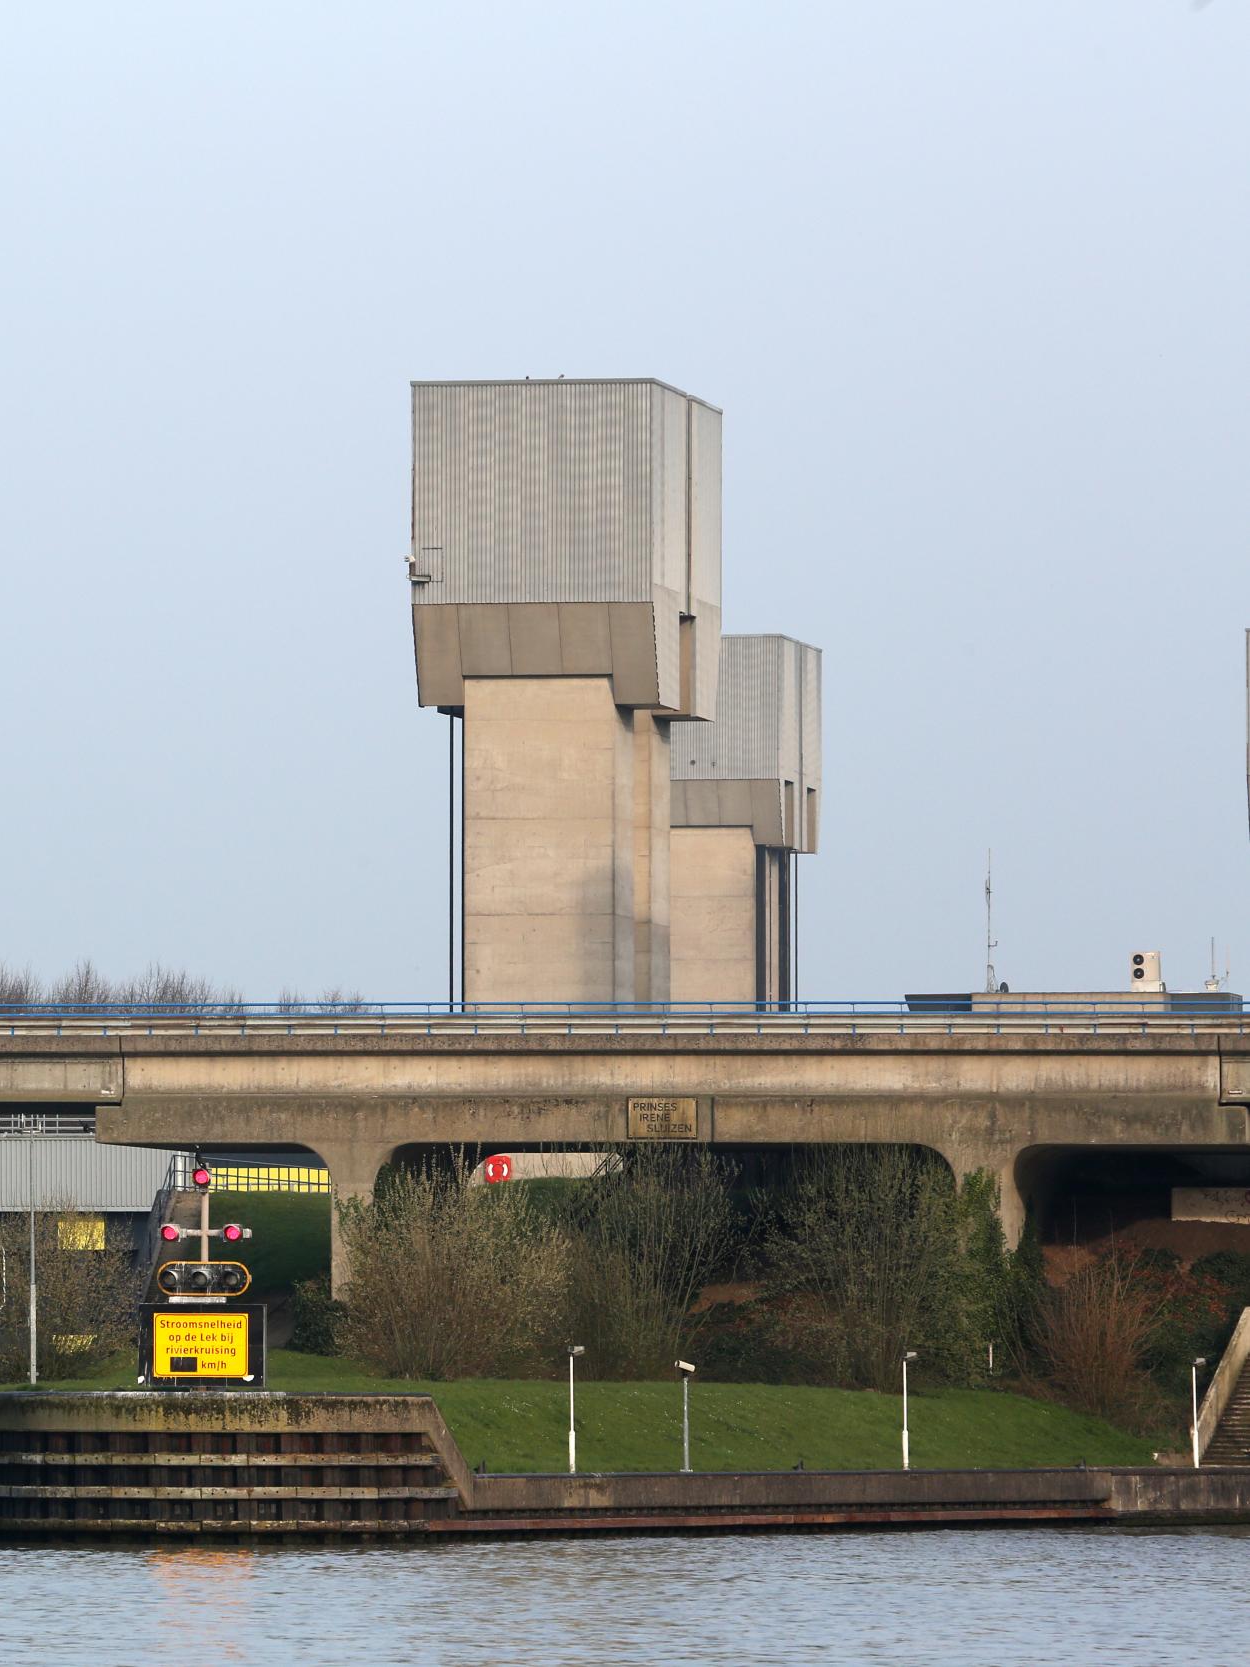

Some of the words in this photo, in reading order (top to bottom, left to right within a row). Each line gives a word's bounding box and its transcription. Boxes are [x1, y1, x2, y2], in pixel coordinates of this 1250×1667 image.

[633, 1102, 677, 1112] PRINSES
[639, 1113, 670, 1122] IRENE
[646, 1123, 692, 1133] SLUIZEN
[160, 1320, 242, 1329] Stroomsnelheid
[168, 1334, 181, 1343] op
[184, 1333, 197, 1342] de
[200, 1333, 217, 1342] Lek
[221, 1333, 234, 1344] bij
[166, 1346, 236, 1357] rivierkruising
[201, 1360, 227, 1371] km/h
